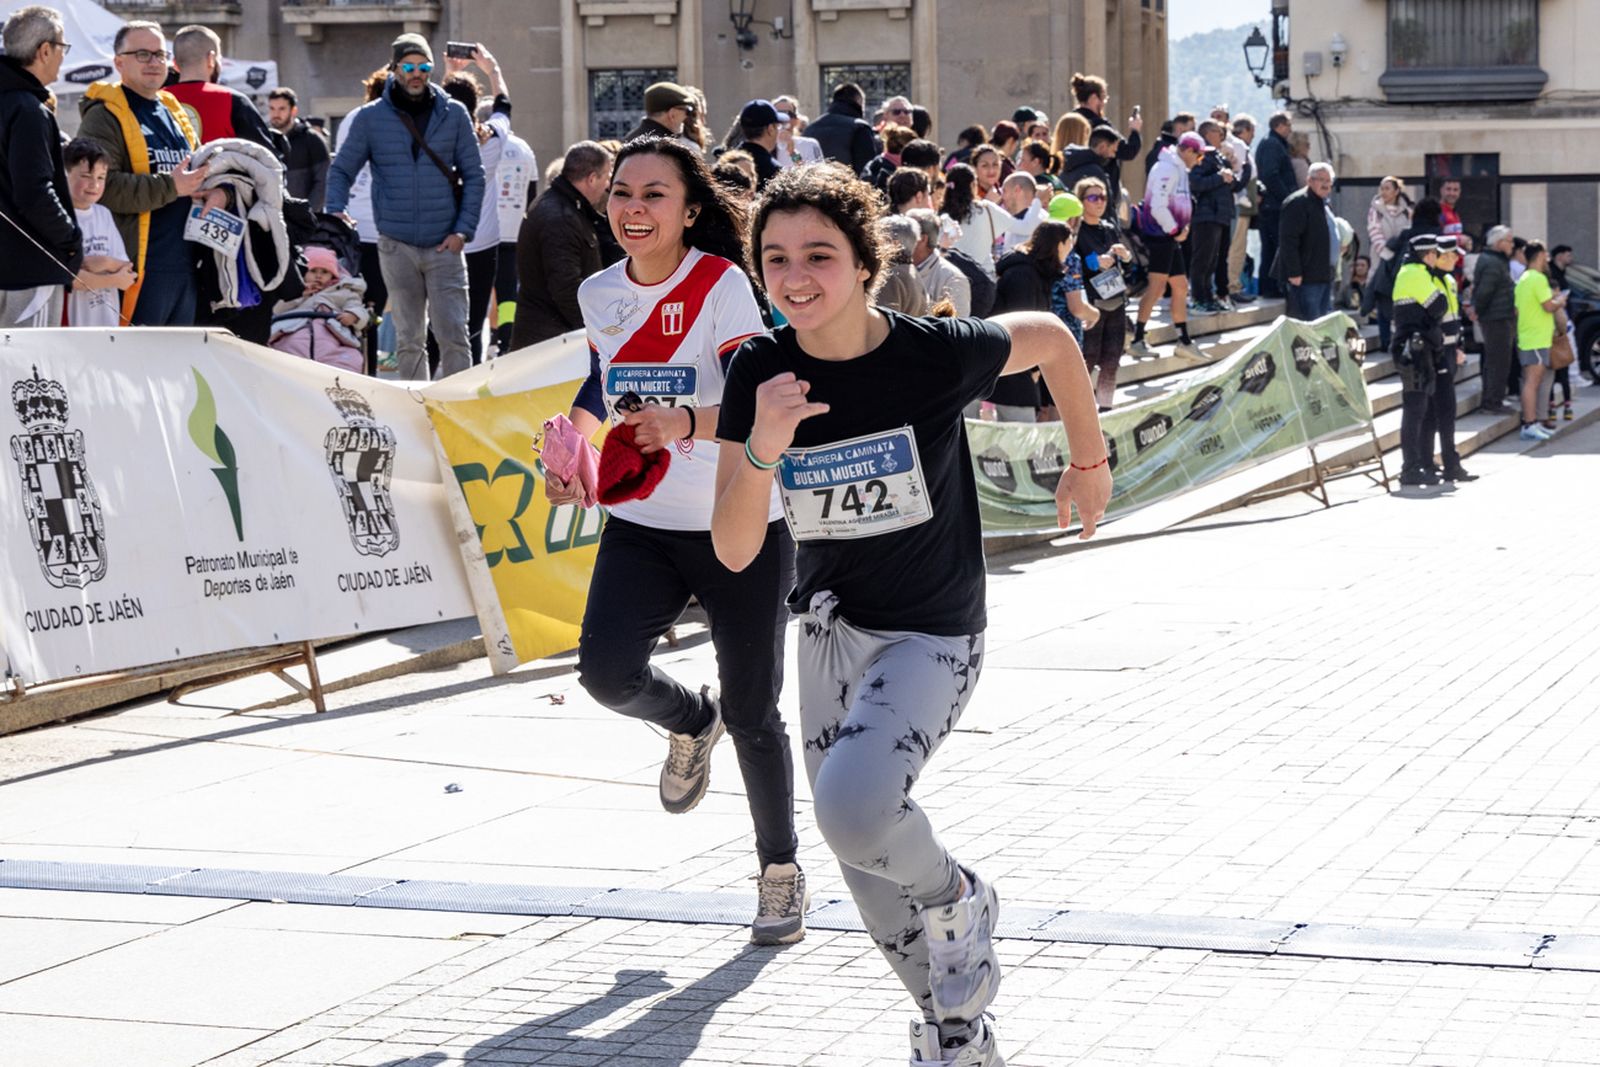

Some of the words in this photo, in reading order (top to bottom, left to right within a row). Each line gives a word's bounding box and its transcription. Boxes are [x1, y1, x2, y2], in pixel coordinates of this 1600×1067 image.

[200, 222, 230, 243] 439
[614, 380, 639, 393] BUENA
[640, 380, 671, 393] MUERTE
[616, 369, 623, 378] VI
[623, 369, 652, 378] CARRERA
[652, 369, 687, 378] CAMINATA
[801, 452, 844, 467] CARRERA
[845, 440, 896, 460] CAMINATA
[793, 468, 829, 486] BUENA
[830, 460, 878, 482] MUERTE
[812, 479, 894, 519] 742
[185, 554, 236, 575] Patronato
[237, 547, 288, 571] Municipal
[288, 546, 299, 565] de
[204, 577, 252, 600] Deportes
[255, 573, 269, 591] de
[270, 570, 296, 591] Jaén
[337, 570, 384, 593] CIUDAD
[384, 568, 401, 587] DE
[403, 561, 433, 585] JAÉN
[24, 605, 84, 633] CIUDAD
[85, 602, 106, 625] DE
[107, 593, 144, 622] JAÉN
